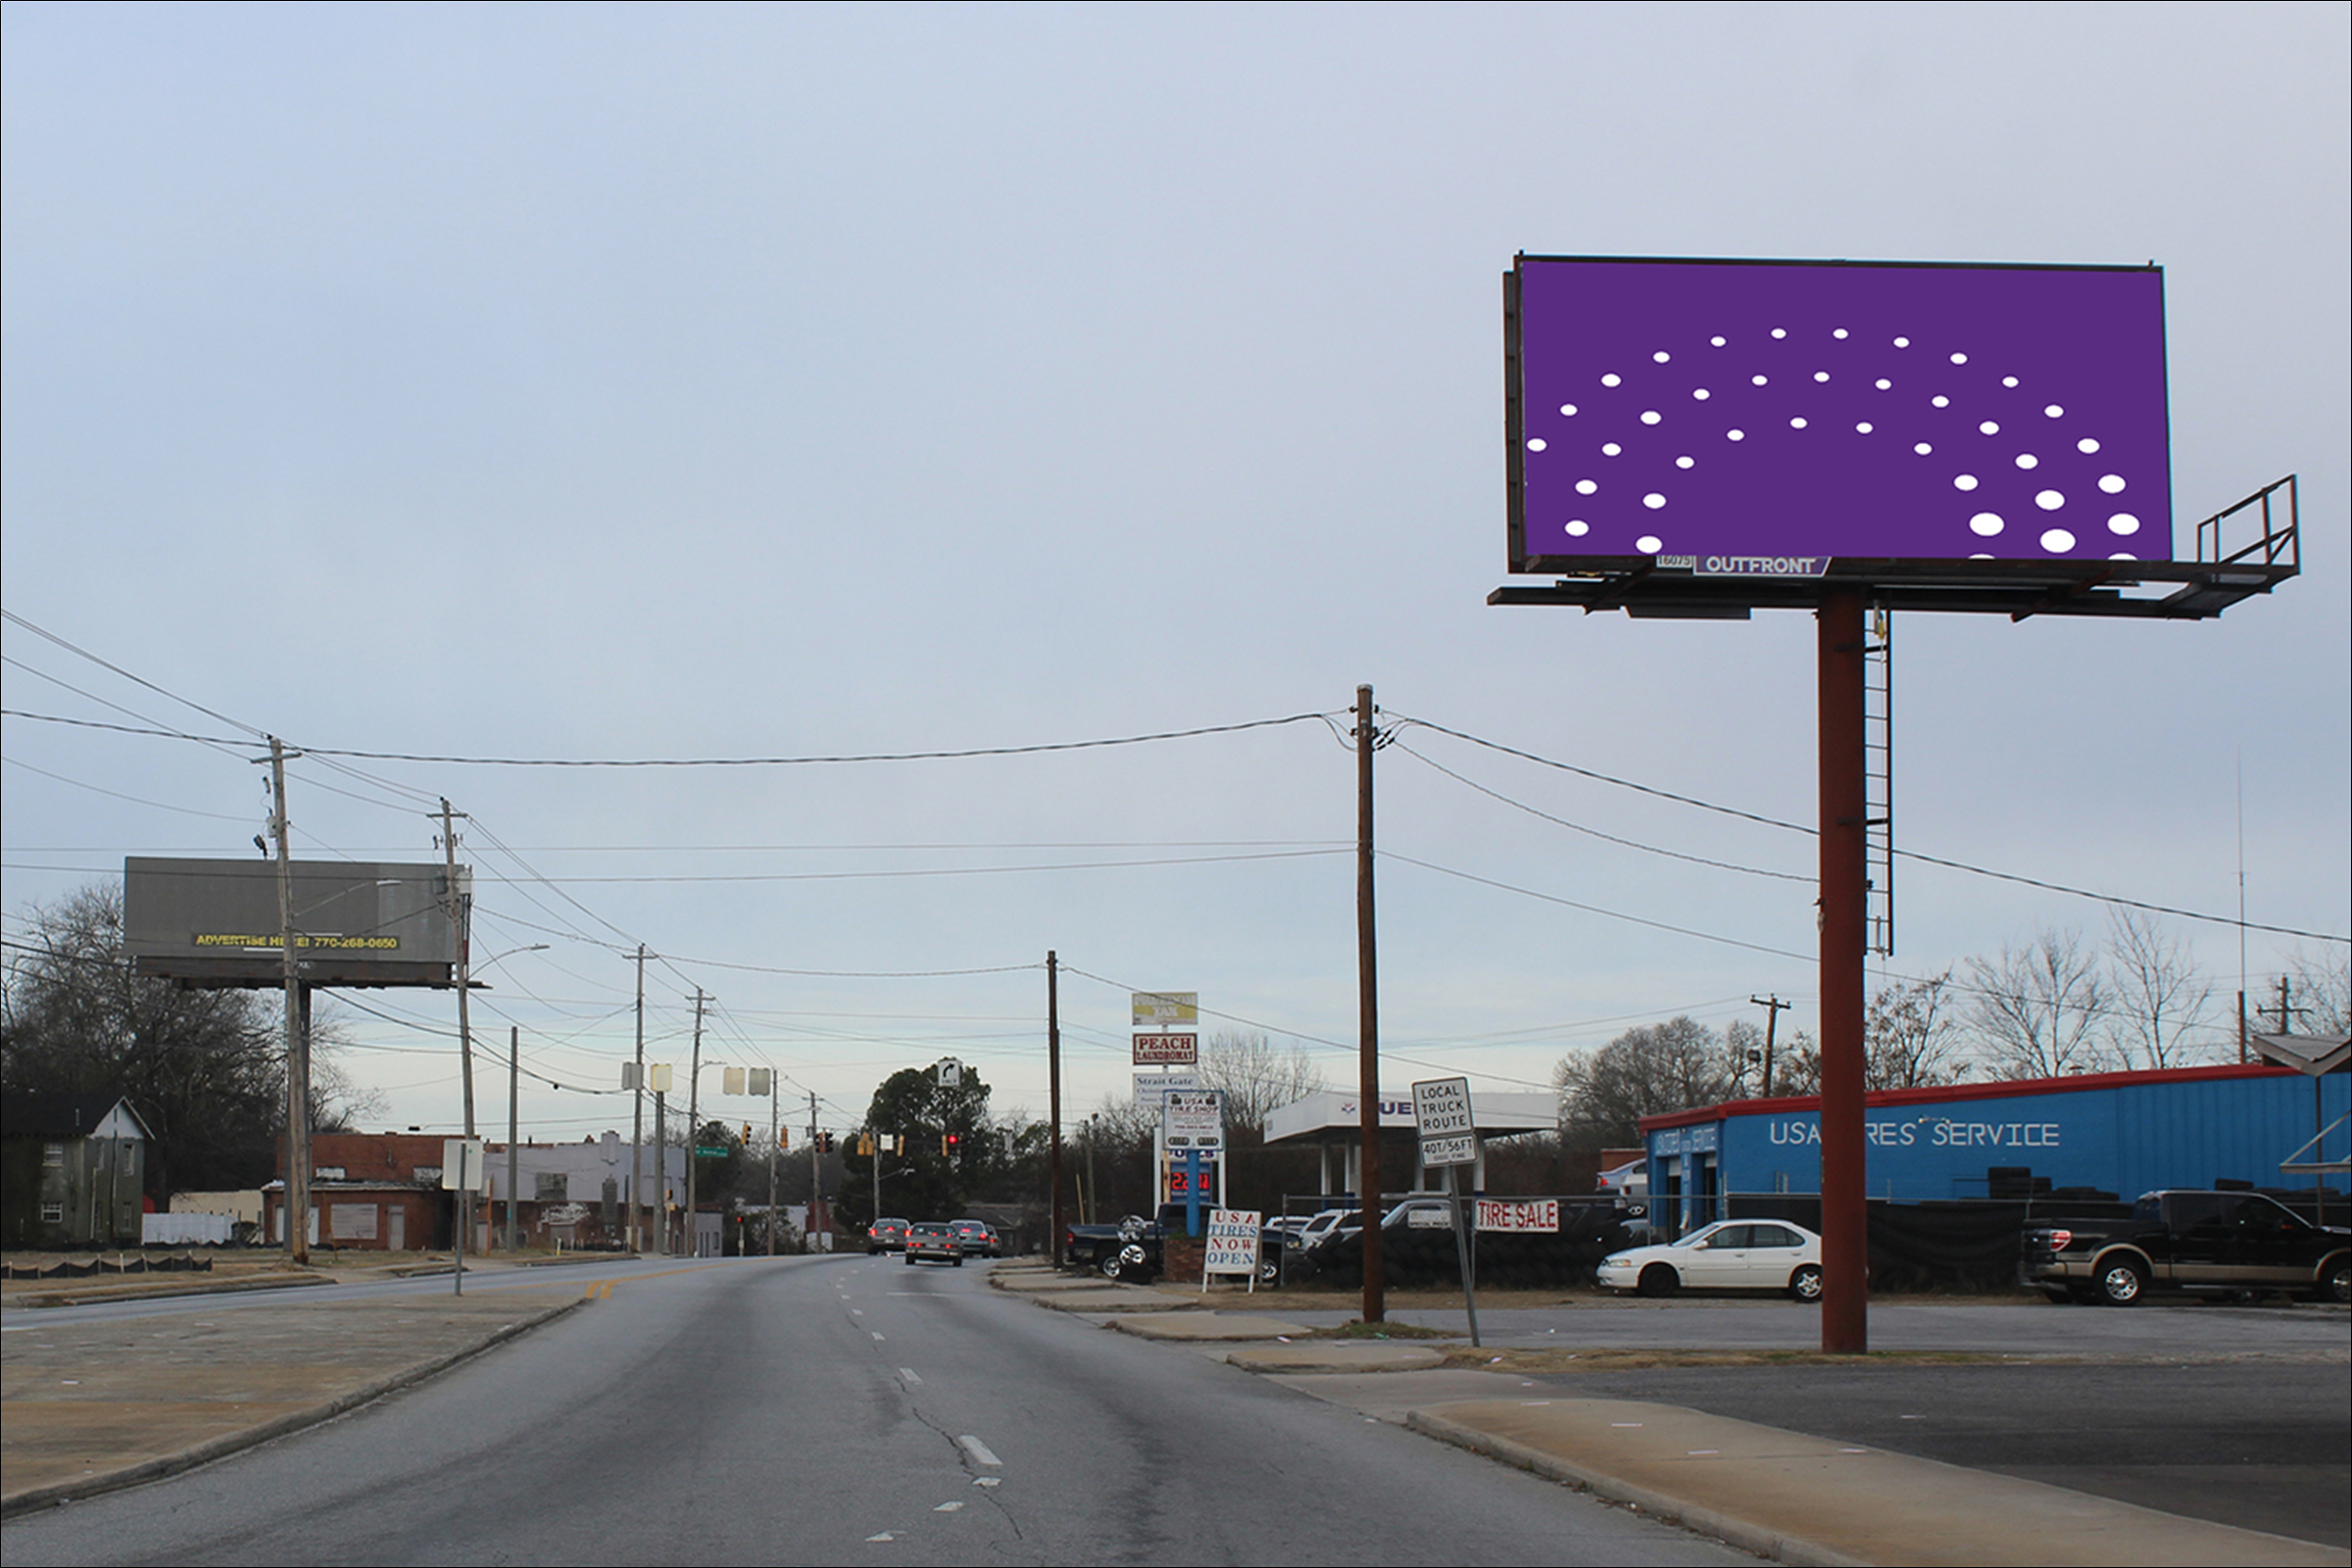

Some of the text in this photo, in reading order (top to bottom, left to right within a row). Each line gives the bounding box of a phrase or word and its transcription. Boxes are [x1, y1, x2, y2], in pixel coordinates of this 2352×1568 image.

[1705, 556, 1817, 573] OUTFRONT
[196, 935, 267, 947] ADVERTISE
[270, 936, 310, 948] HE!
[1139, 1037, 1192, 1050] PEACH
[1136, 1051, 1194, 1060] LAUNDROMAT
[1168, 1076, 1194, 1086] Gate
[1420, 1085, 1460, 1100] LOCAL
[1192, 1104, 1219, 1114] SHOP
[1421, 1100, 1465, 1114] TRUCK
[1423, 1115, 1467, 1130] ROUTE
[1770, 1122, 2060, 1147] USA RES SERVICE
[1215, 1210, 1256, 1224] USA
[1478, 1201, 1511, 1228] TIRE
[1515, 1202, 1556, 1228] SALE
[1209, 1224, 1258, 1237] TIRES
[1210, 1238, 1254, 1251] NOW
[1206, 1251, 1254, 1265] OPEN
